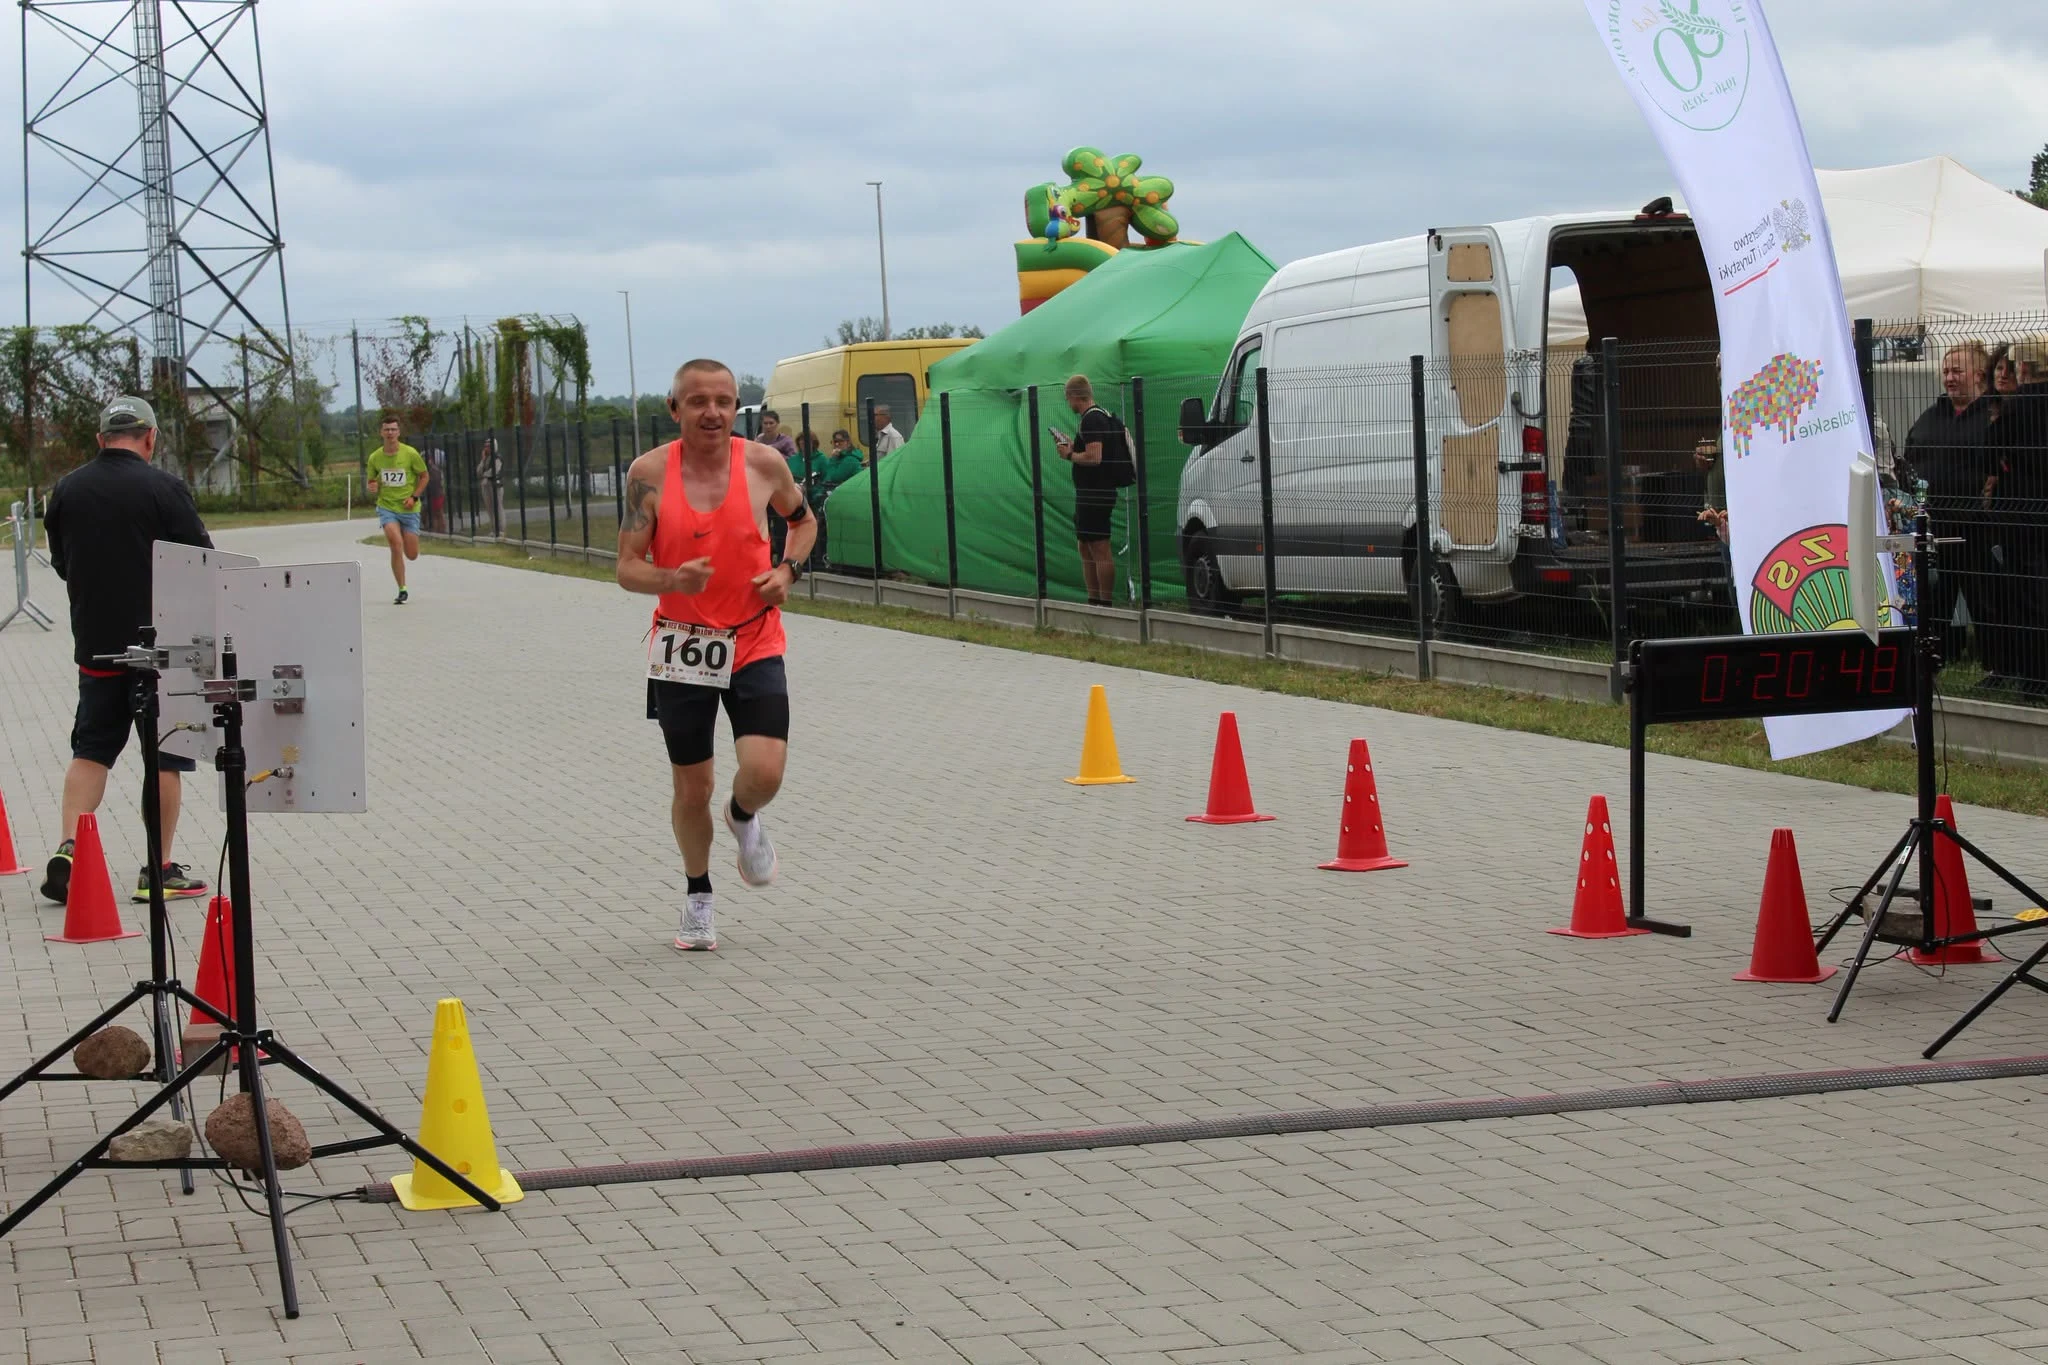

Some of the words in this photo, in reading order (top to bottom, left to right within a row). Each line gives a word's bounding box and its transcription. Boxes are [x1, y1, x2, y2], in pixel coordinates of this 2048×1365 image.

[383, 472, 404, 482] 127
[661, 633, 727, 671] 160
[1701, 647, 1898, 703] 0:20:48
